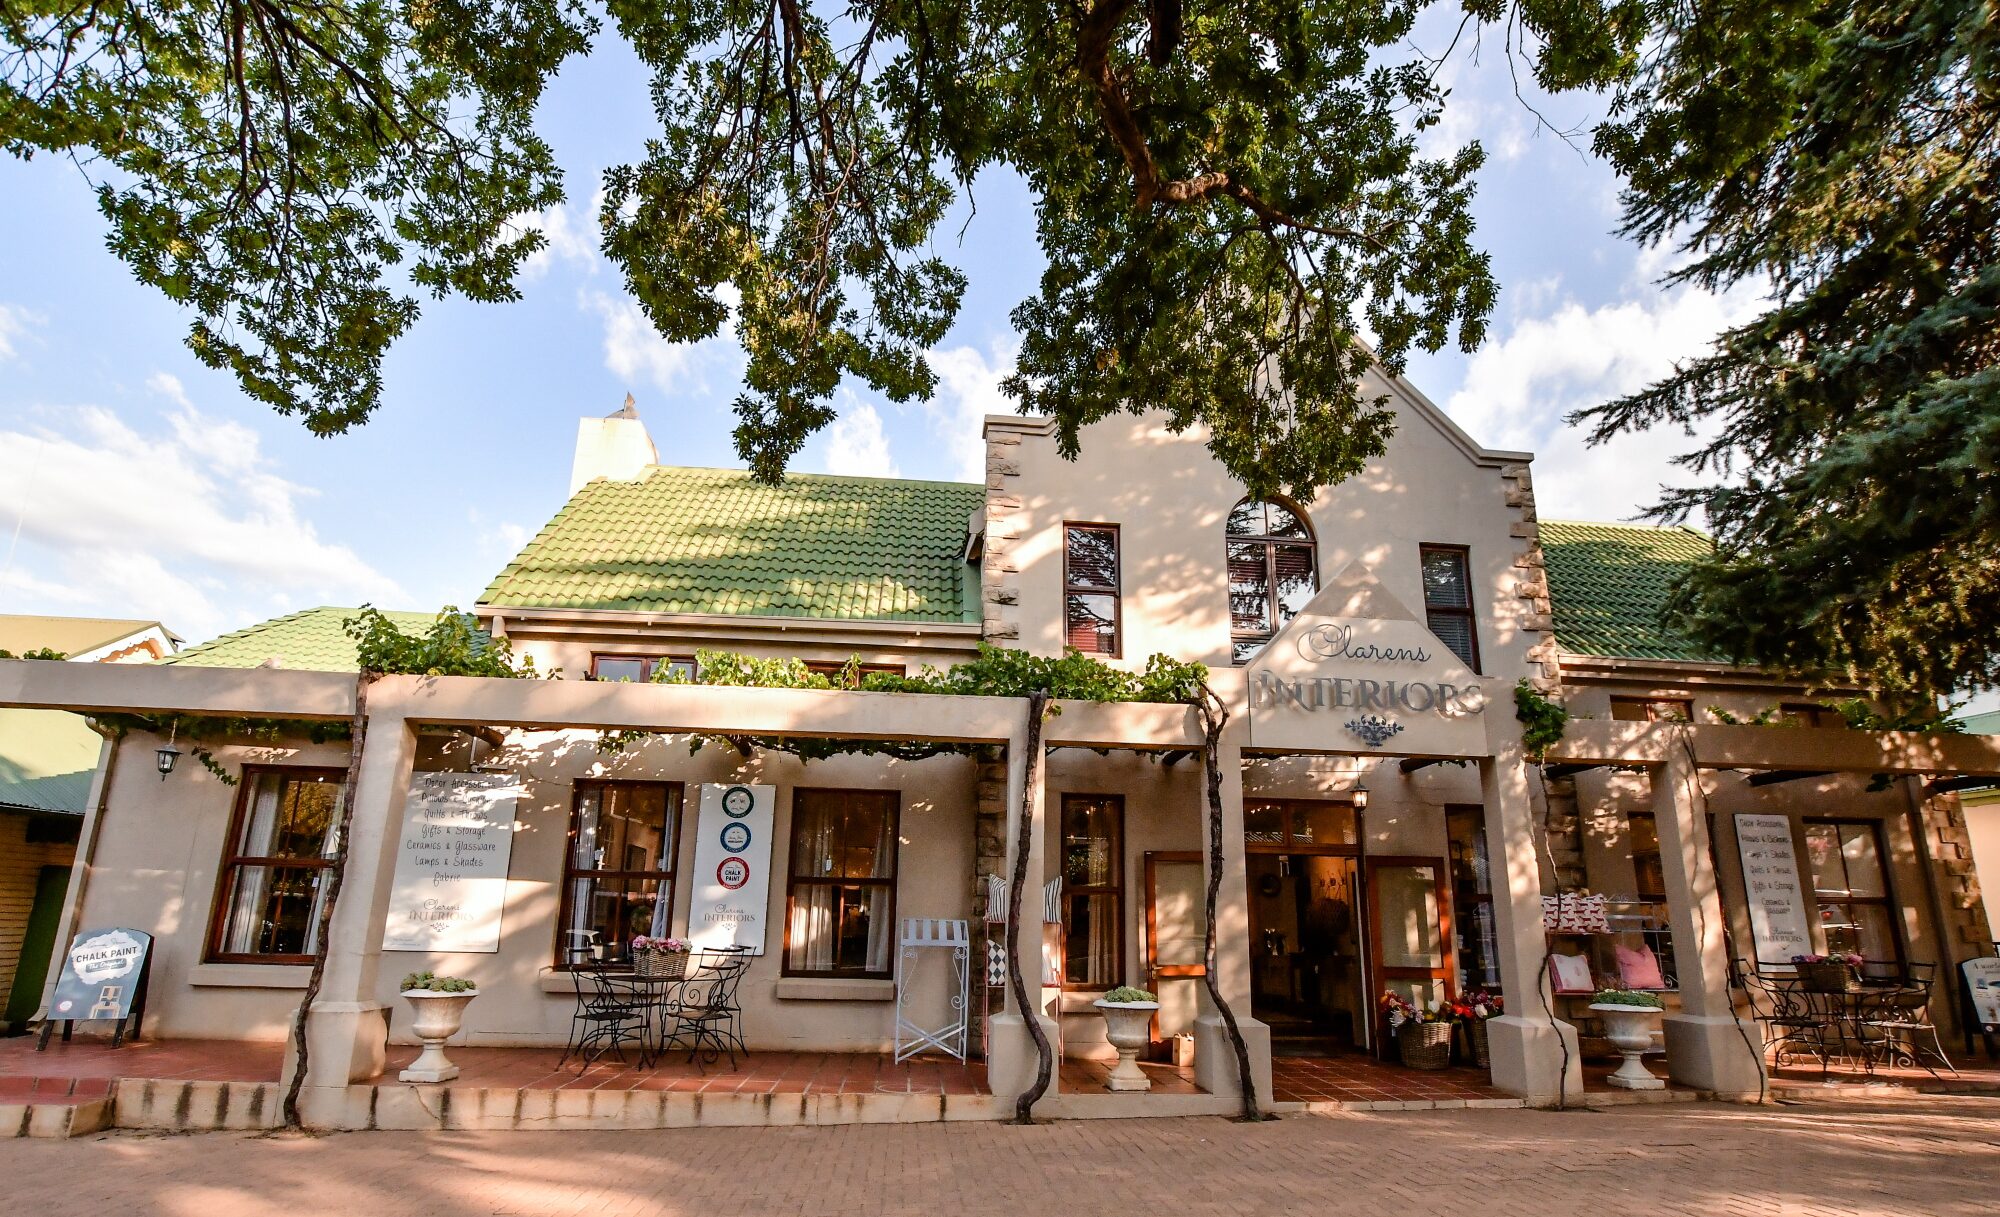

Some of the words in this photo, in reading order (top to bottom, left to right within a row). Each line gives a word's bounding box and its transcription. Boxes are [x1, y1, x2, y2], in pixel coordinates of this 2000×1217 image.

[1297, 623, 1431, 663] Clarens
[1247, 670, 1486, 714] INTERIORS
[424, 809, 446, 822] Quilts
[421, 825, 442, 838] Gifts
[455, 827, 486, 840] Storage
[407, 840, 442, 850] Ceramics
[455, 841, 496, 855] Glassware
[415, 856, 440, 867] Lamps
[453, 857, 484, 867] Shades
[704, 913, 756, 922] INTERIORS
[76, 951, 107, 963] CHALK
[110, 946, 137, 958] PAINT
